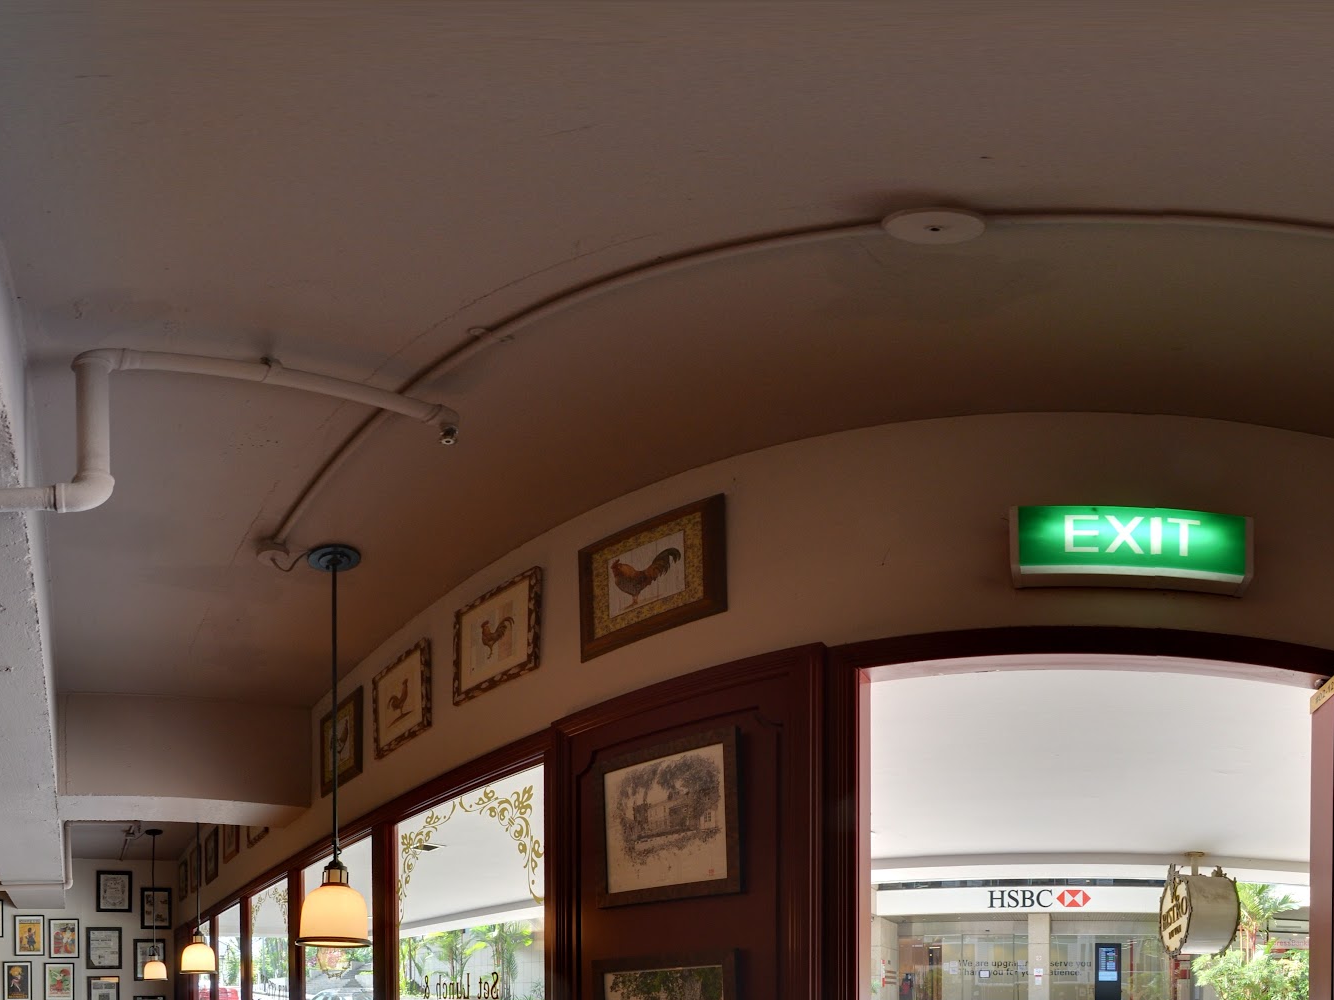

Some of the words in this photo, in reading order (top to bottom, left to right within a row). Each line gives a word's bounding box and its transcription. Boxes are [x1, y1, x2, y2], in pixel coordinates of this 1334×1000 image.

[1064, 514, 1201, 557] EXIT
[988, 889, 1053, 909] HSBC
[1162, 896, 1188, 931] BISTRO
[1077, 960, 1091, 968] you
